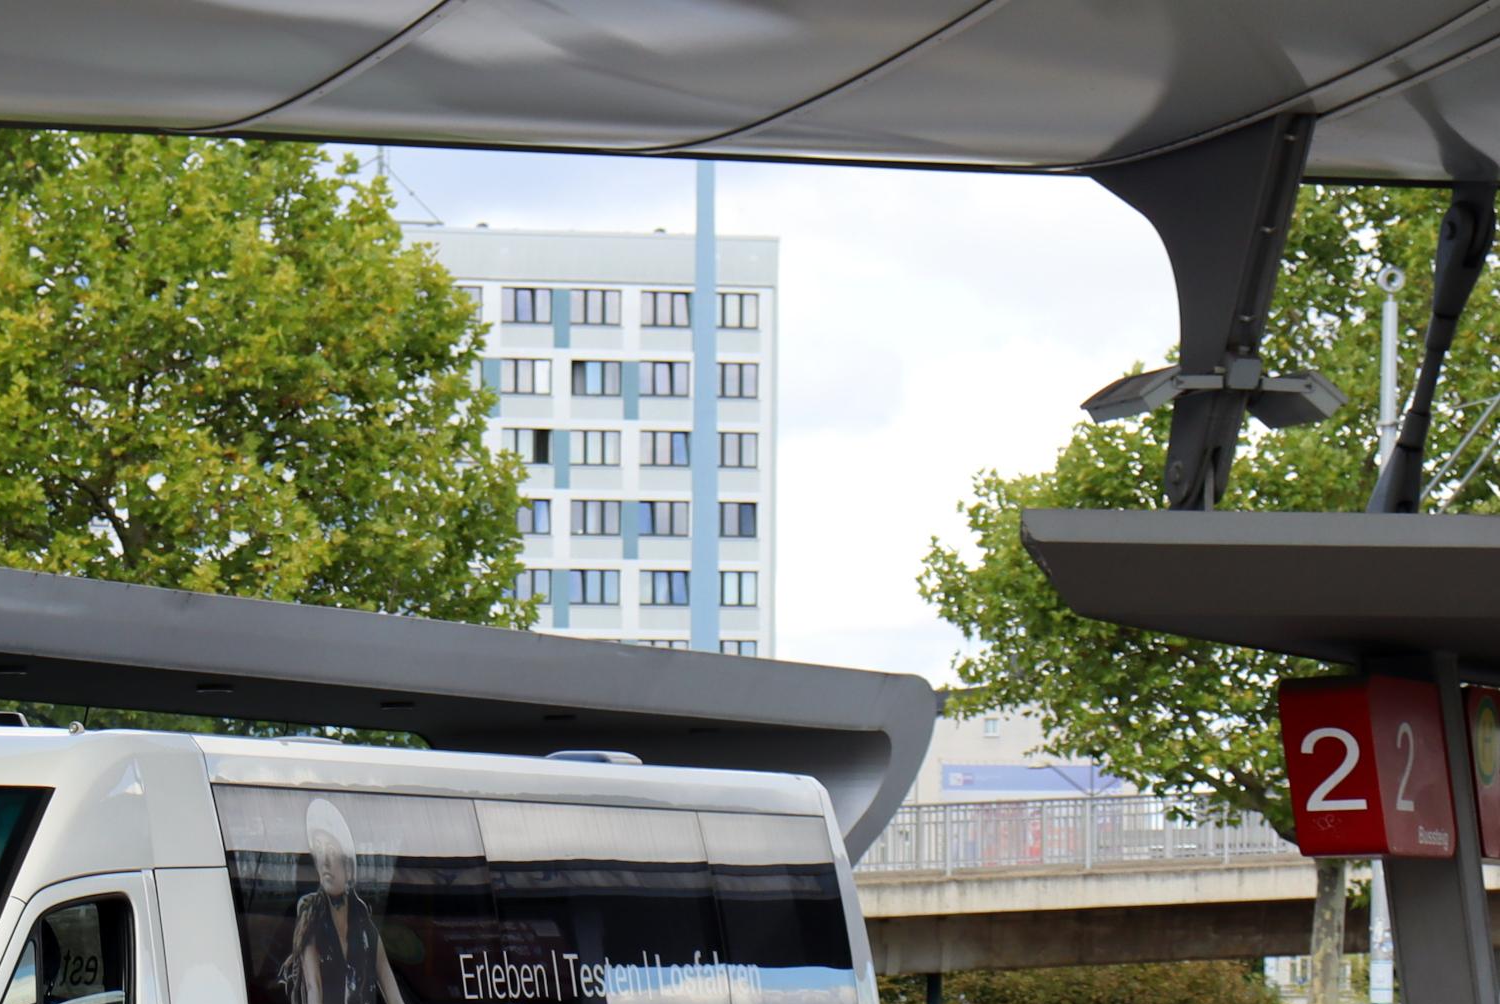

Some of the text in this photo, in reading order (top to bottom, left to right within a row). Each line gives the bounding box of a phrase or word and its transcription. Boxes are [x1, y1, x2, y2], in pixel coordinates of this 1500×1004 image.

[1301, 727, 1368, 812] 2
[1395, 722, 1415, 812] 2
[459, 951, 549, 1000] Erleben
[562, 953, 640, 999] Testen
[654, 950, 763, 998] Losfahren
